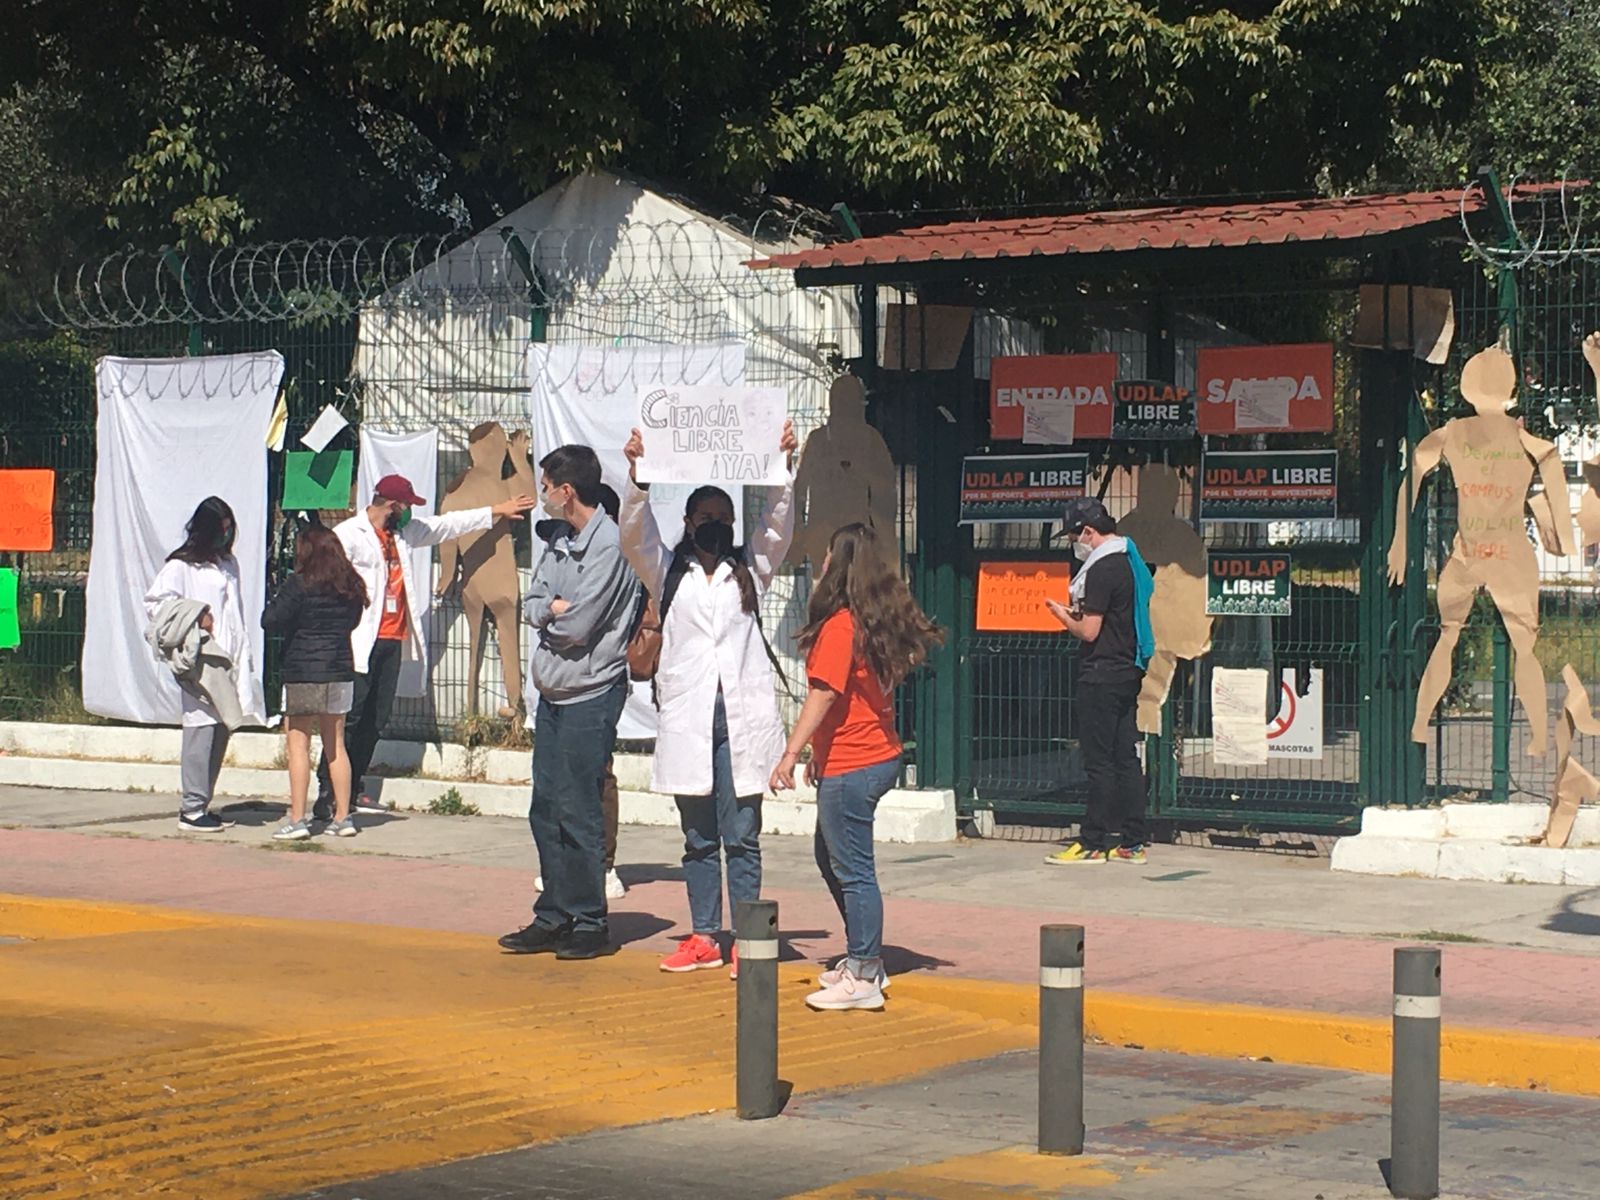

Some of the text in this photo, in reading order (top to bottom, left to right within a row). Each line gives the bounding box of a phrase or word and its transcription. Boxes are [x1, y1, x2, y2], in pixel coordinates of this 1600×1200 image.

[996, 386, 1109, 407] ENTRADA
[1118, 384, 1190, 402] UDLAP
[1206, 375, 1322, 404] SADA
[1127, 404, 1181, 420] LIBRE
[673, 429, 744, 453] LIBRE
[710, 453, 770, 480] ¡YA!
[965, 470, 1084, 488] UDLAP LIBRE
[1206, 467, 1333, 485] UDLAP LIBRE
[1461, 482, 1514, 500] CAMPUS
[1465, 516, 1521, 531] UDLAP
[1213, 559, 1287, 577] UDLAP
[1222, 579, 1276, 595] LIBRE
[1268, 744, 1315, 754] MASCOTAS
